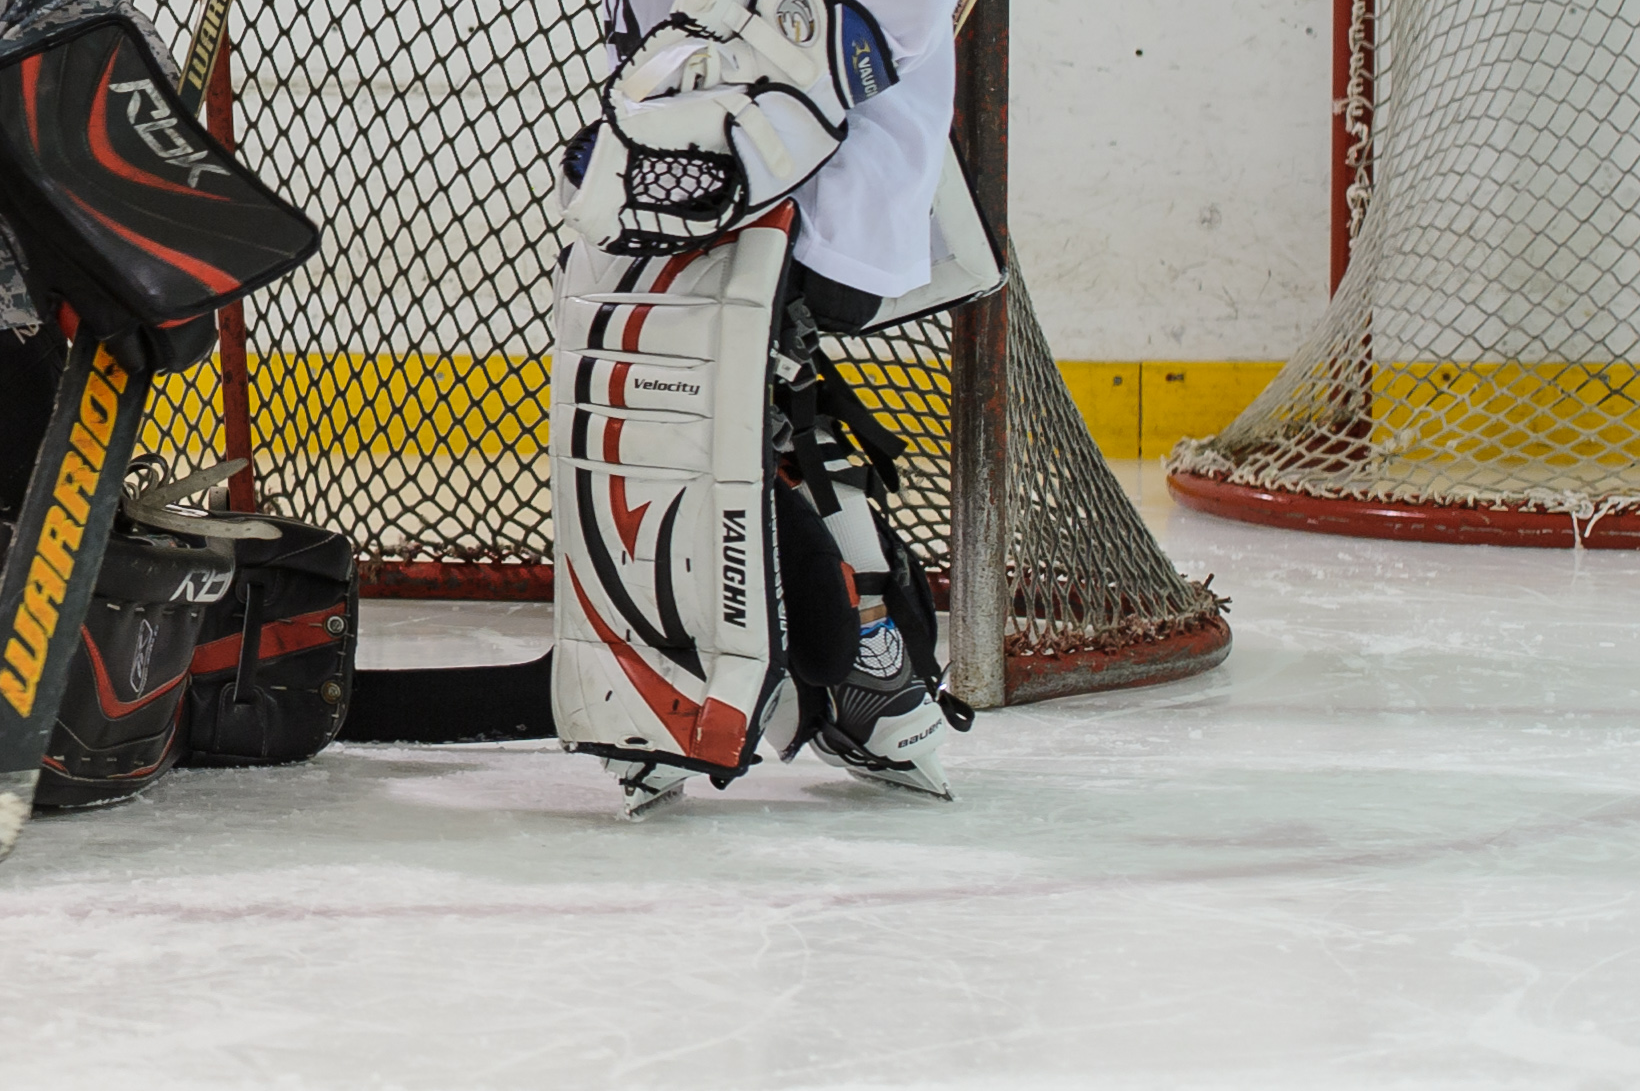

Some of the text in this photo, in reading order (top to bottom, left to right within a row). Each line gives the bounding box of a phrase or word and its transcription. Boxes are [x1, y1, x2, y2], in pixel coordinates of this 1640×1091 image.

[633, 378, 701, 396] Velocity
[722, 509, 747, 629] VAUGHN
[898, 718, 943, 749] BAUER
